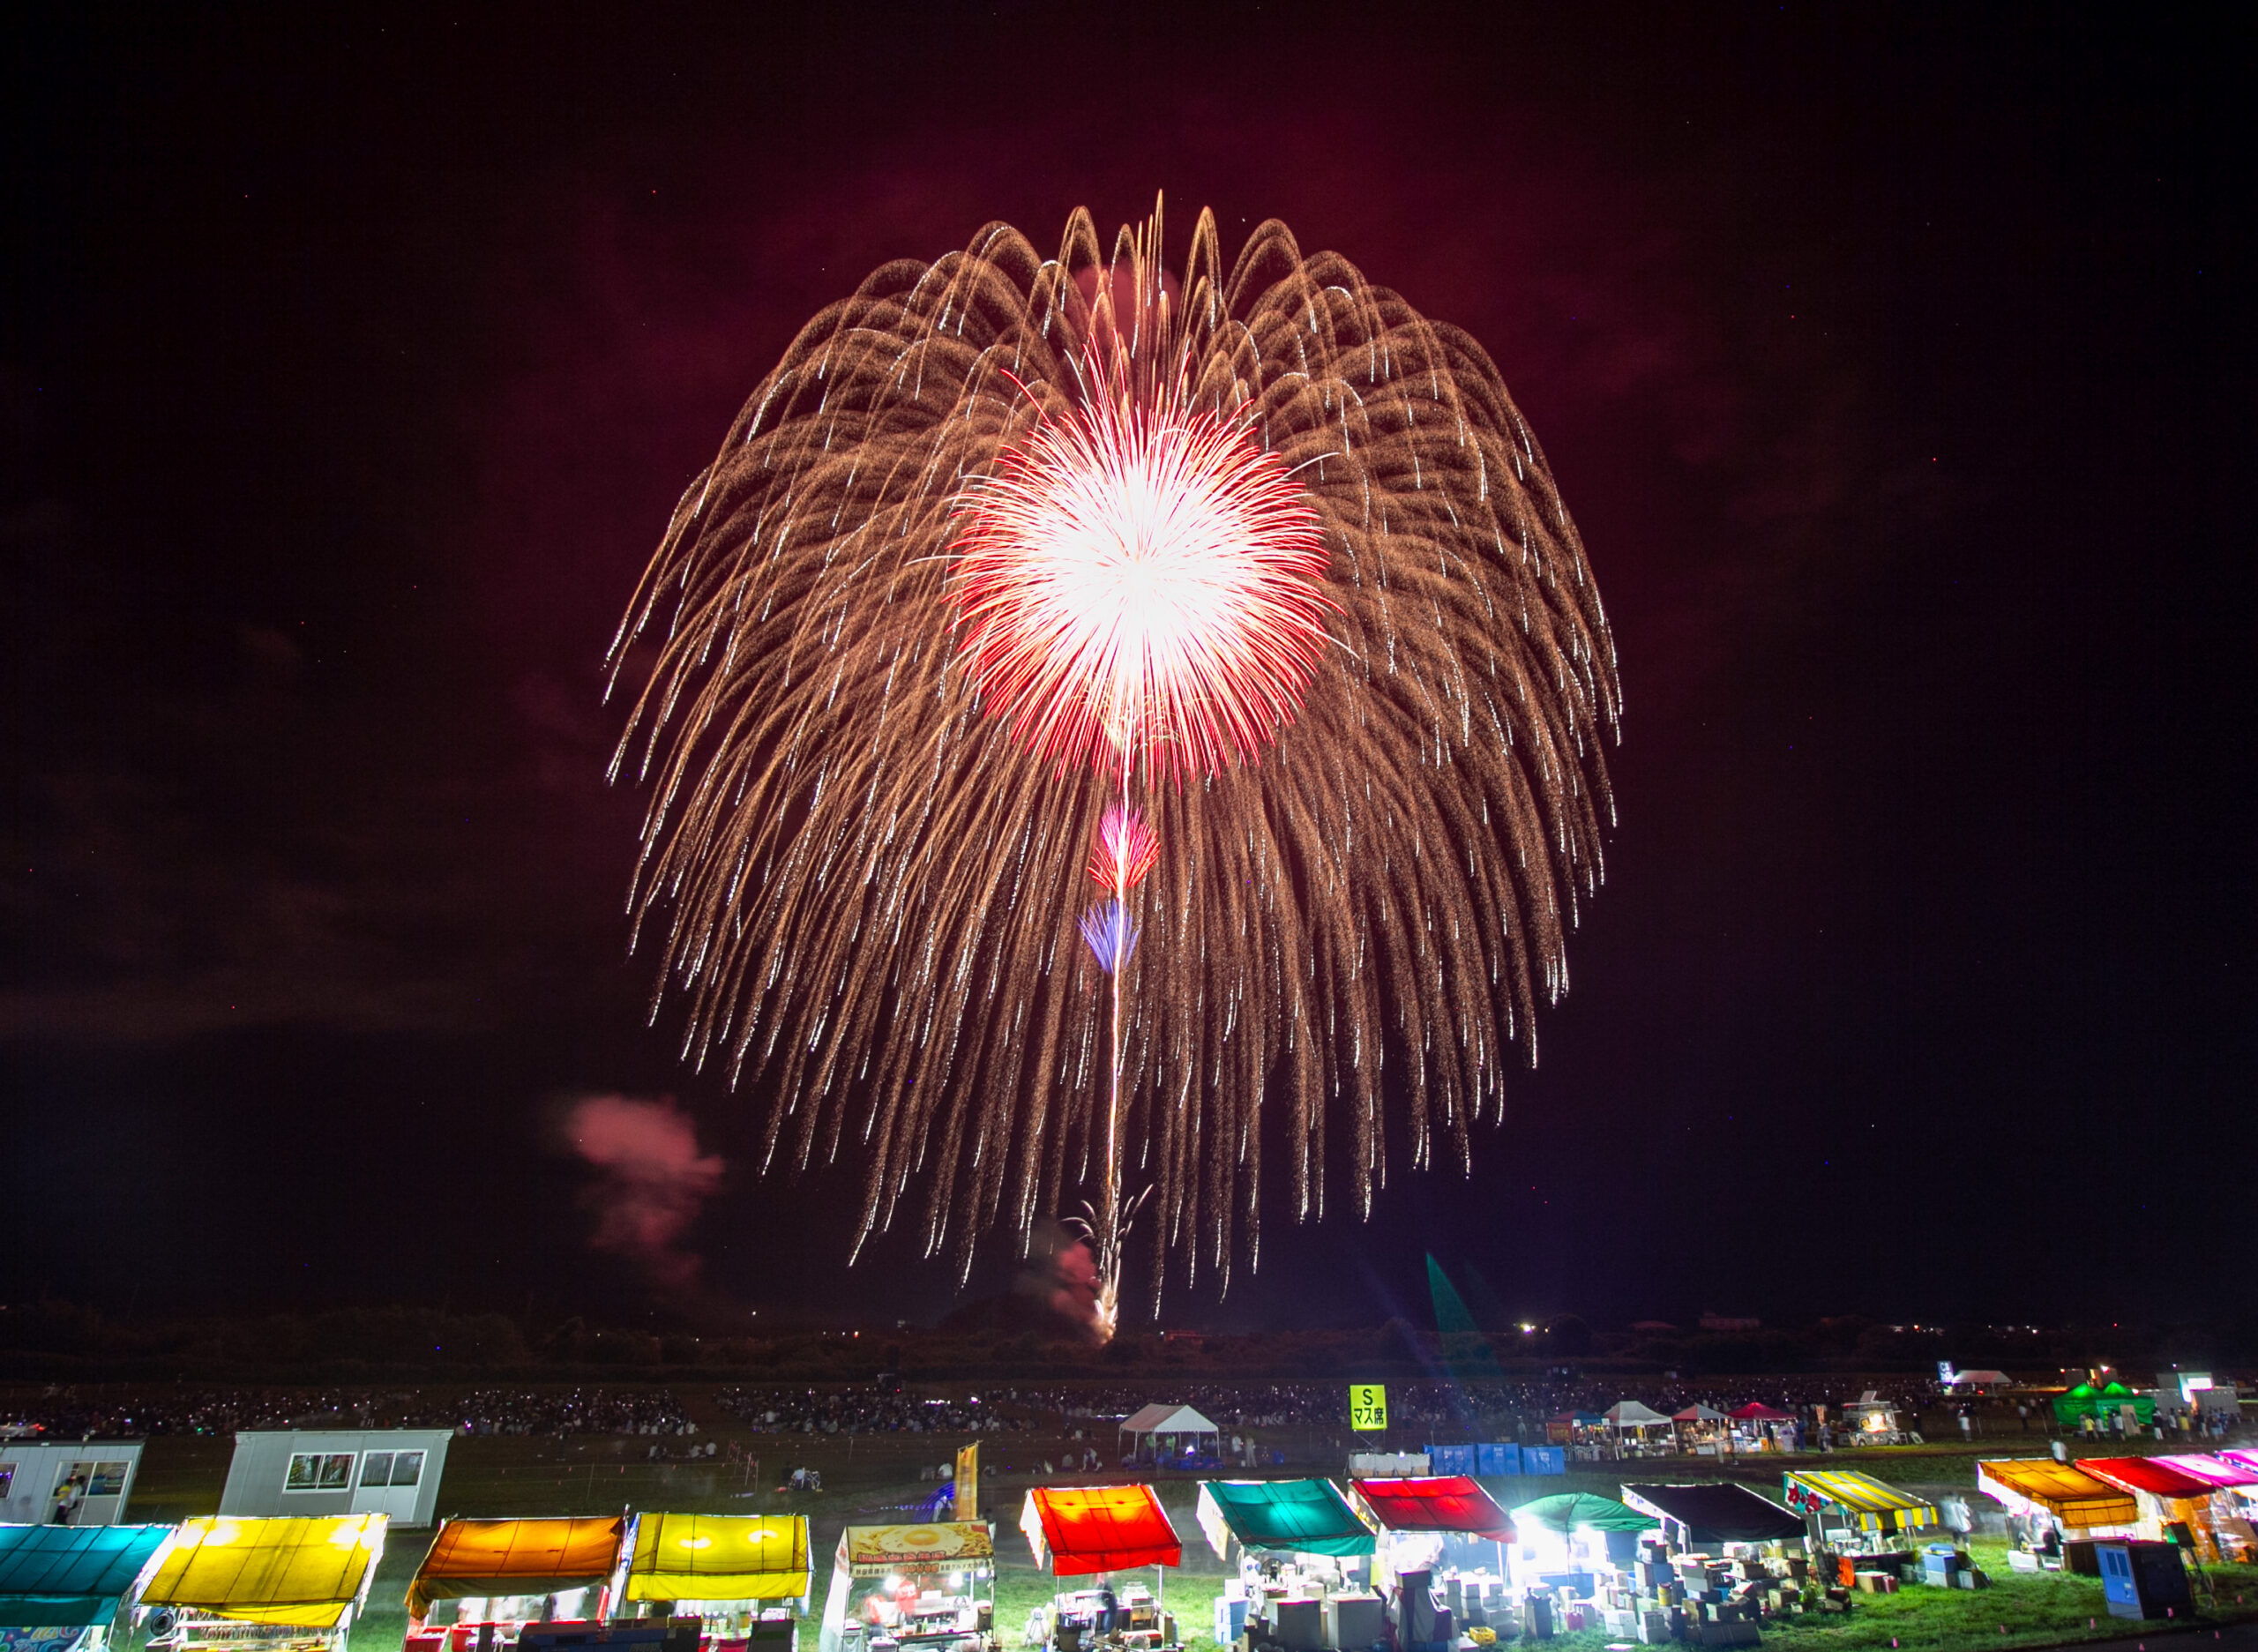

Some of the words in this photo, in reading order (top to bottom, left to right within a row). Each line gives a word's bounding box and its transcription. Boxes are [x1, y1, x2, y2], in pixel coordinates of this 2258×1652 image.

[1363, 1388, 1373, 1405] S
[1354, 1407, 1383, 1425] マス席
